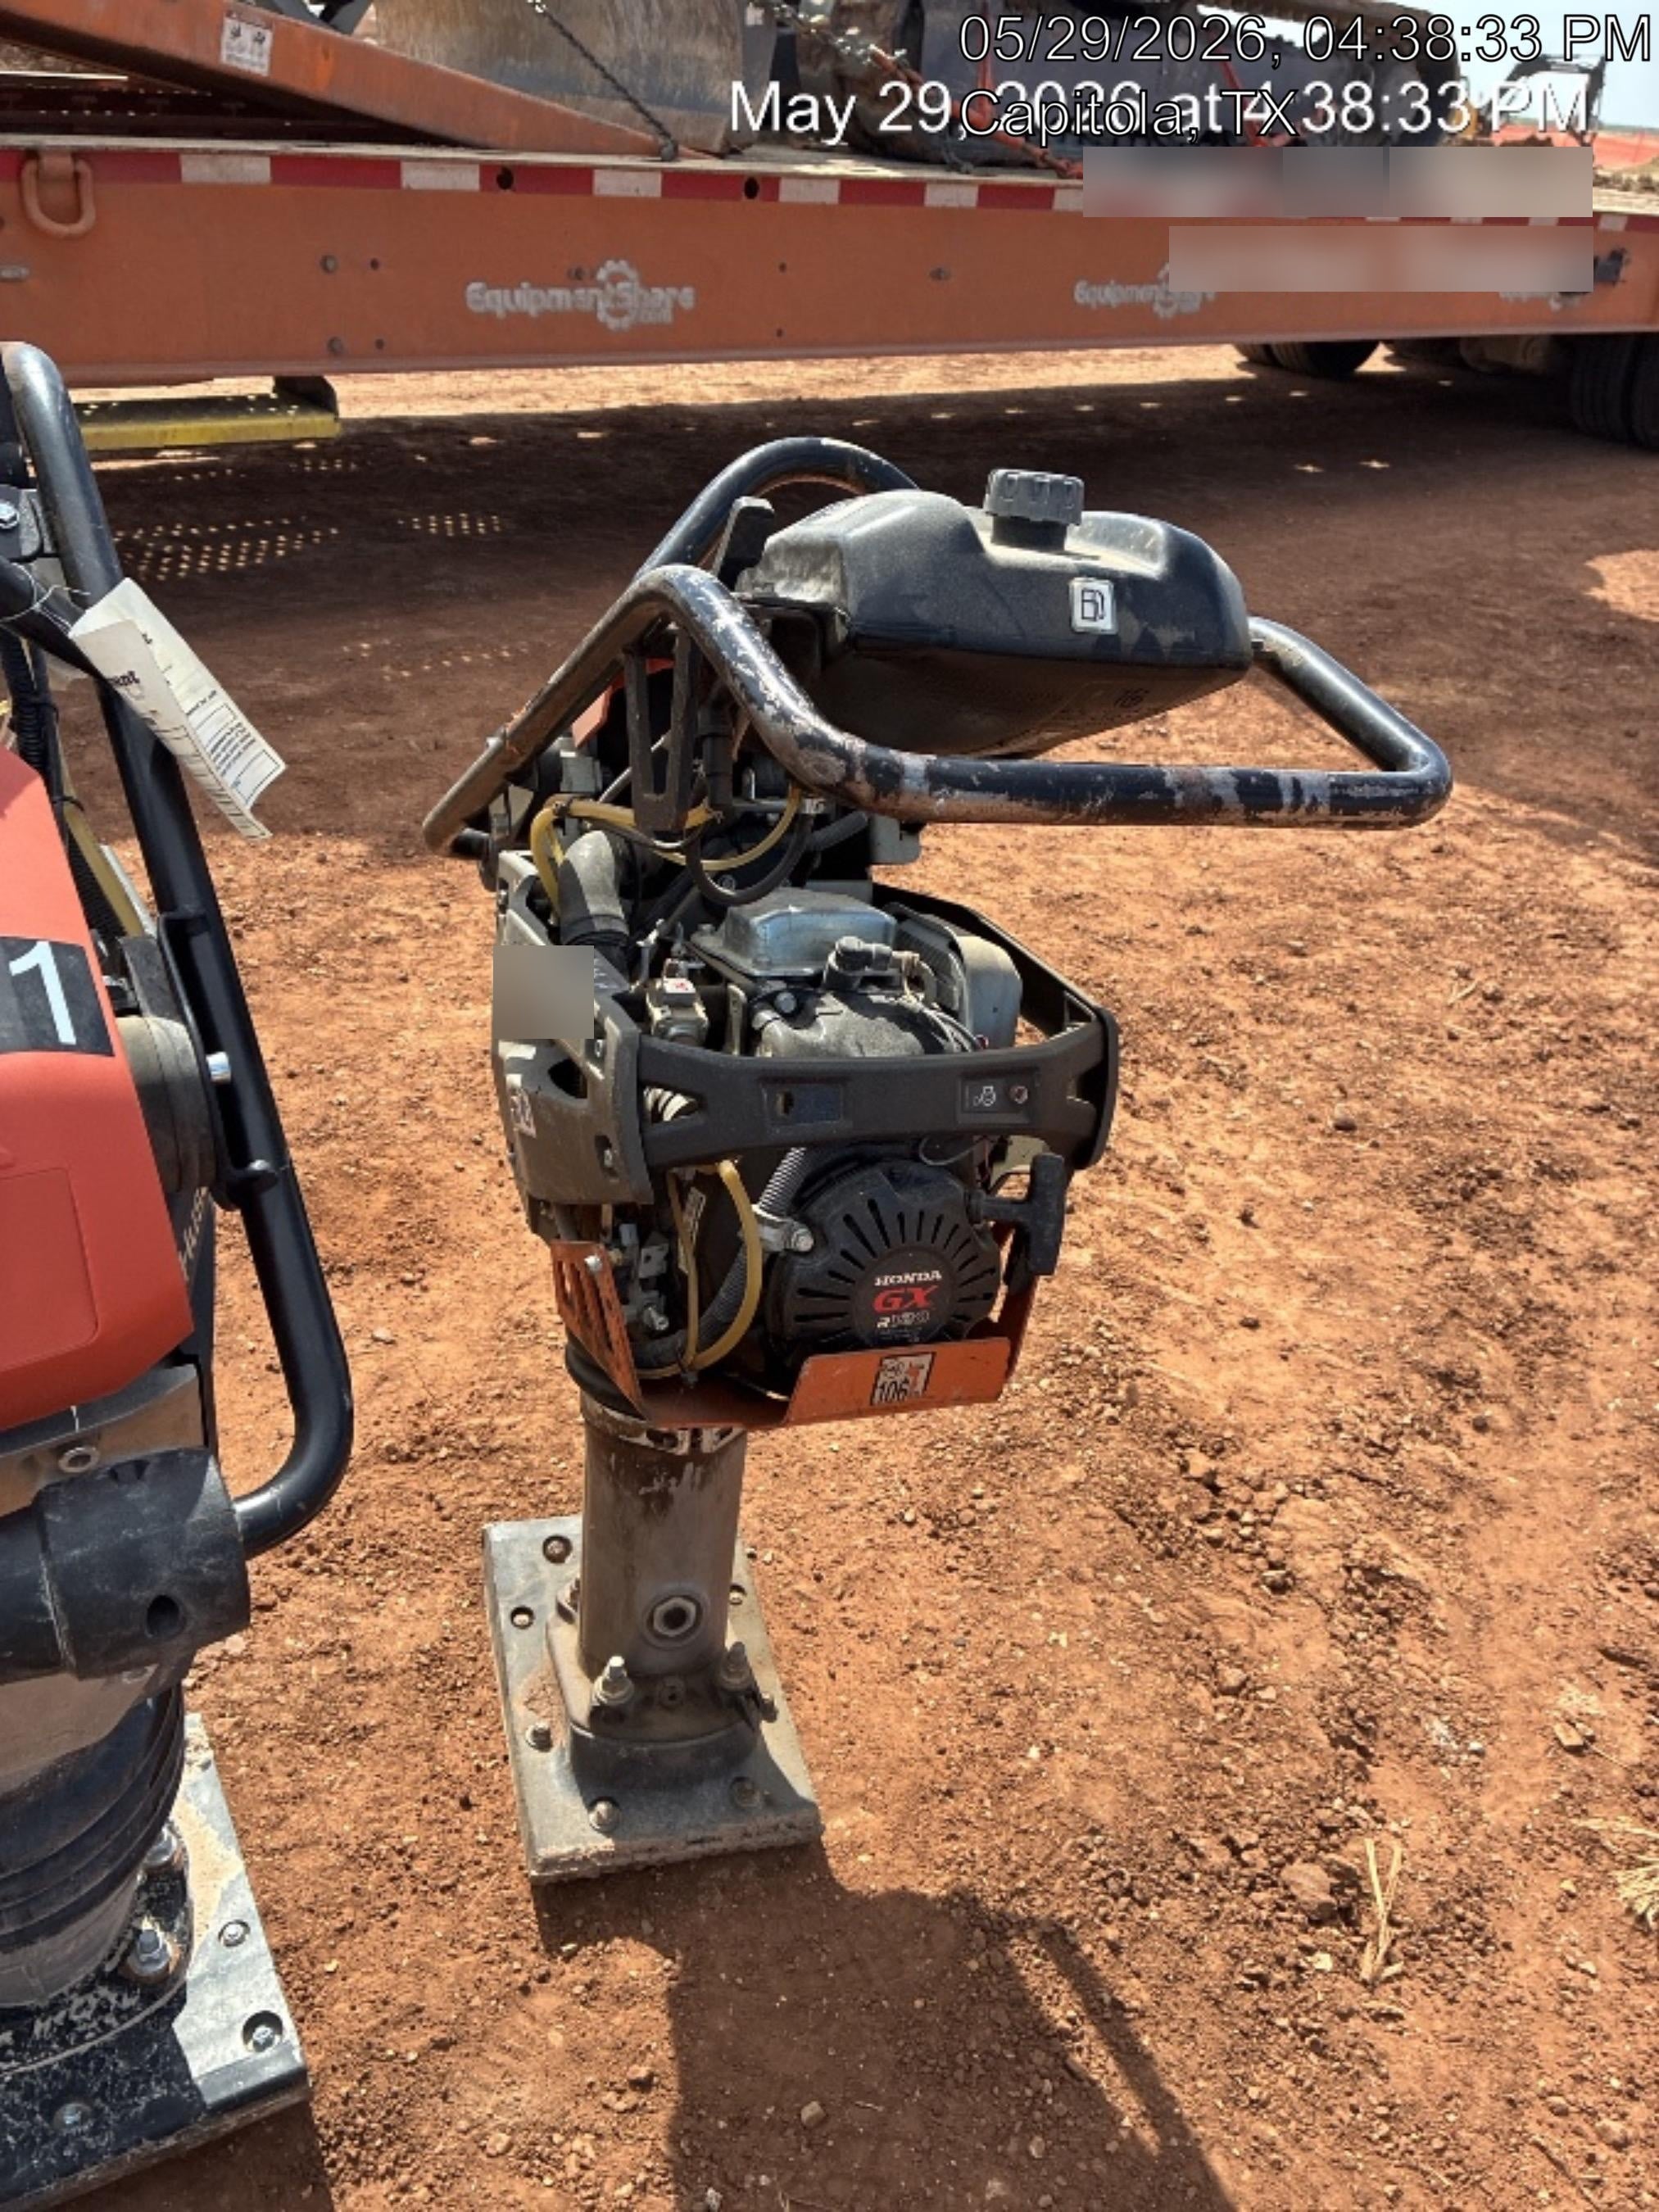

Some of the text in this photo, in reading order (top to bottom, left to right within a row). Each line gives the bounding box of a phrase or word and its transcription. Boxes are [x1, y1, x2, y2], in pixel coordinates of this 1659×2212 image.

[9, 941, 77, 1045] 1
[873, 1270, 943, 1287] HONDA
[873, 1285, 939, 1314] GX
